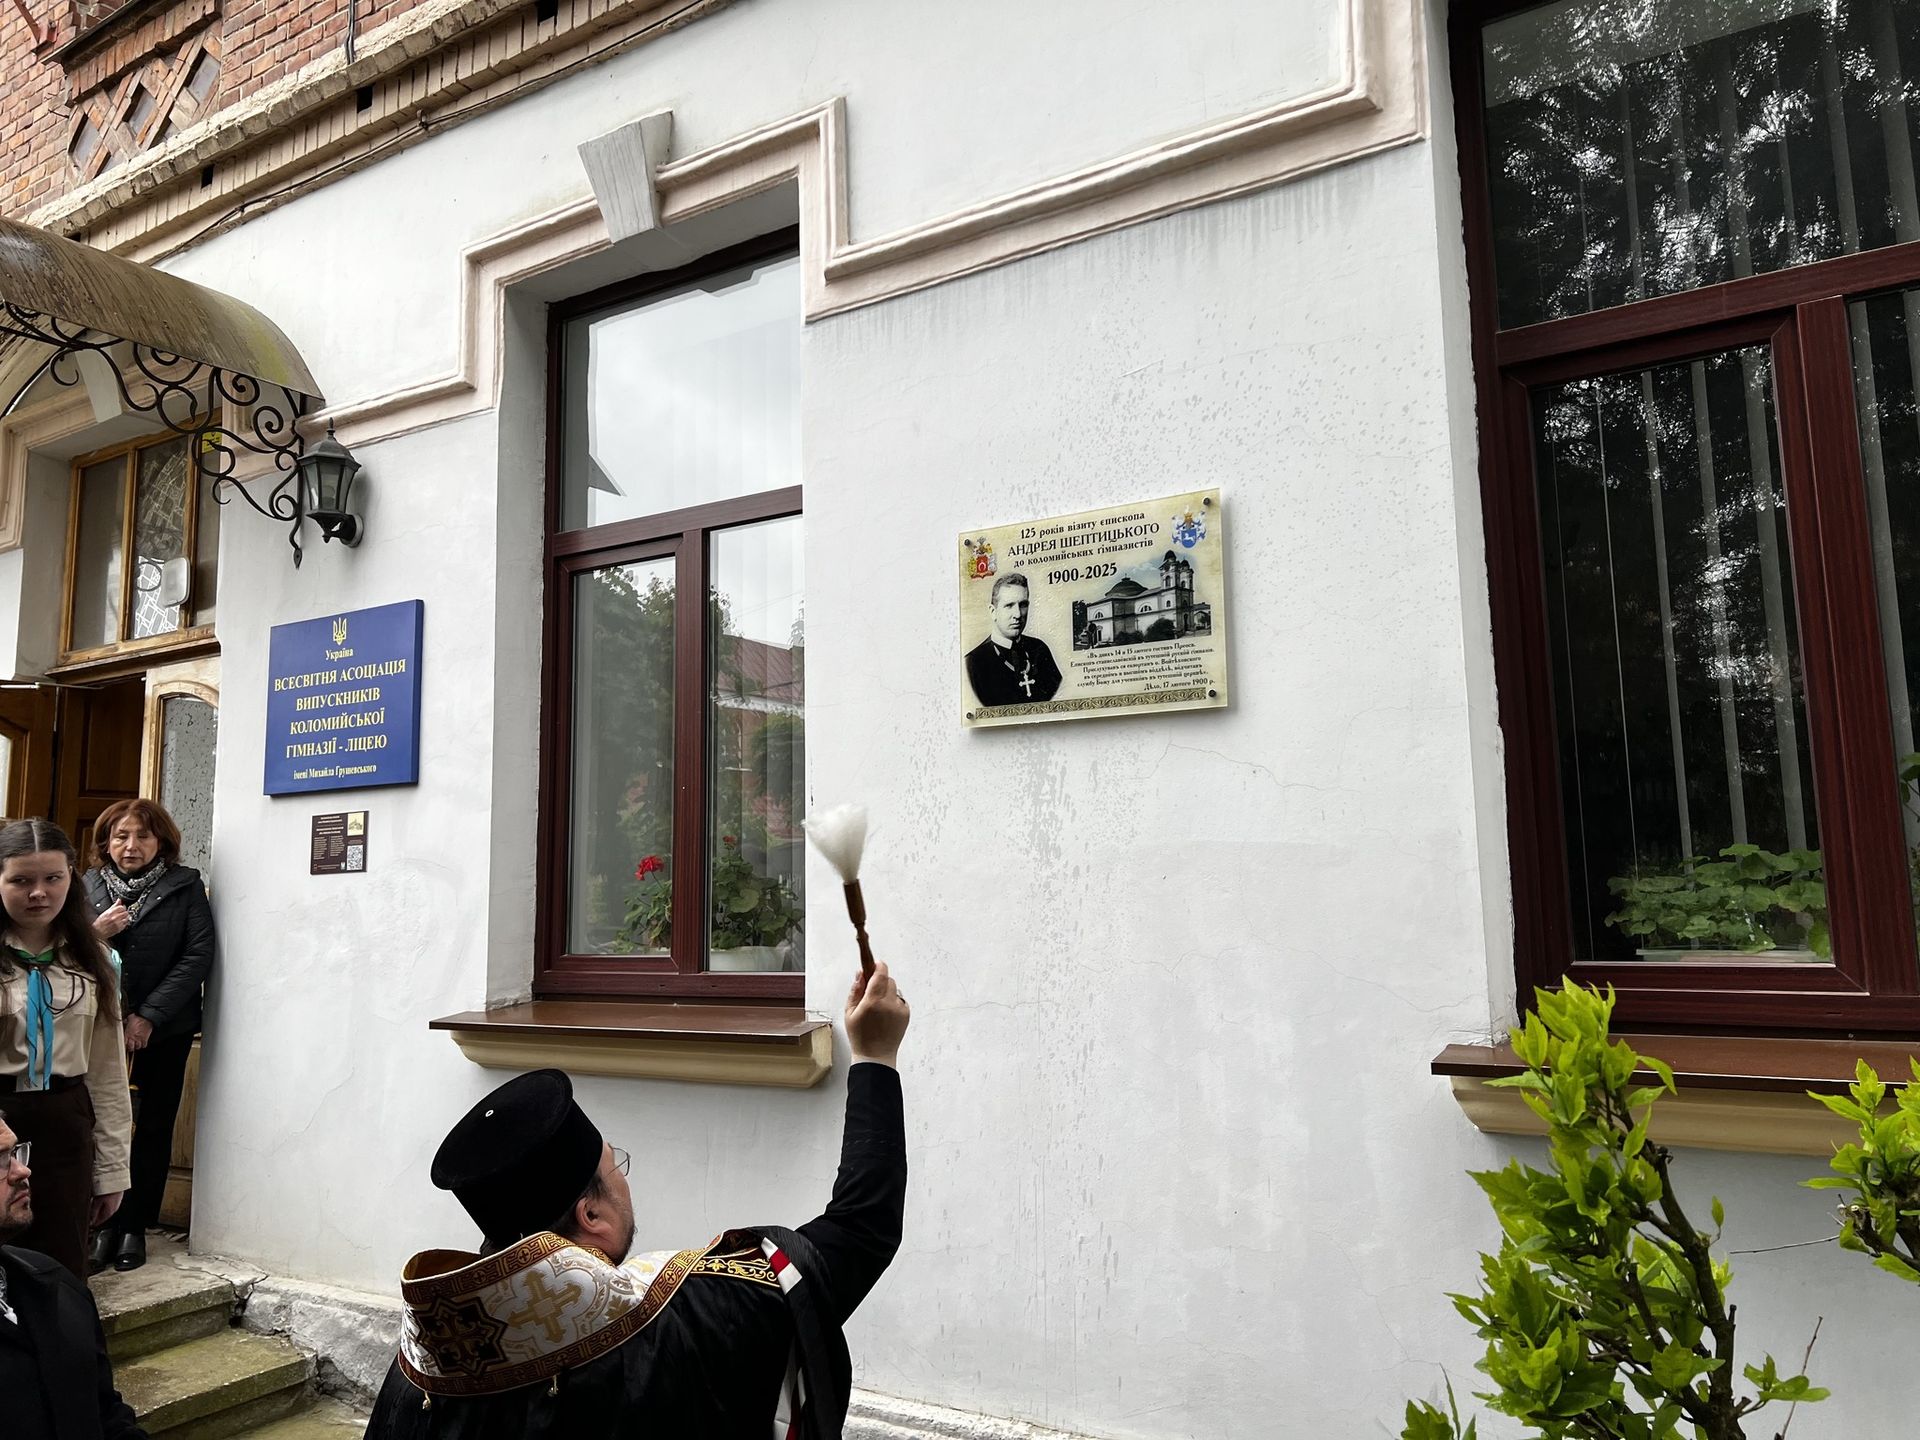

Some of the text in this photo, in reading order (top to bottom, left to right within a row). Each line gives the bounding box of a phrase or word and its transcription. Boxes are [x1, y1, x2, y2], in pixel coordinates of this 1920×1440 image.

[1021, 512, 1145, 539] 125 років візиту єпископа
[1008, 522, 1160, 556] АНДРЕЯ ШЕПТИЦЬКОГО
[1014, 560, 1025, 568] до
[1028, 548, 1094, 565] коломийських
[1047, 562, 1118, 584] 1900-2025
[325, 648, 354, 662] Україна
[274, 658, 406, 692] ВСЕСВІТНЯ АСОЦІАЦІЯ
[1192, 678, 1208, 686] 1900
[296, 687, 380, 712] ВИПУСКНИКІВ
[290, 707, 386, 735] КОЛОМИЙСЬКОЇ
[286, 737, 337, 758] ГІМНАЗІЇ
[344, 734, 388, 752] ЛІЦЕЮ
[294, 764, 377, 780] імені Михайла Грушевського
